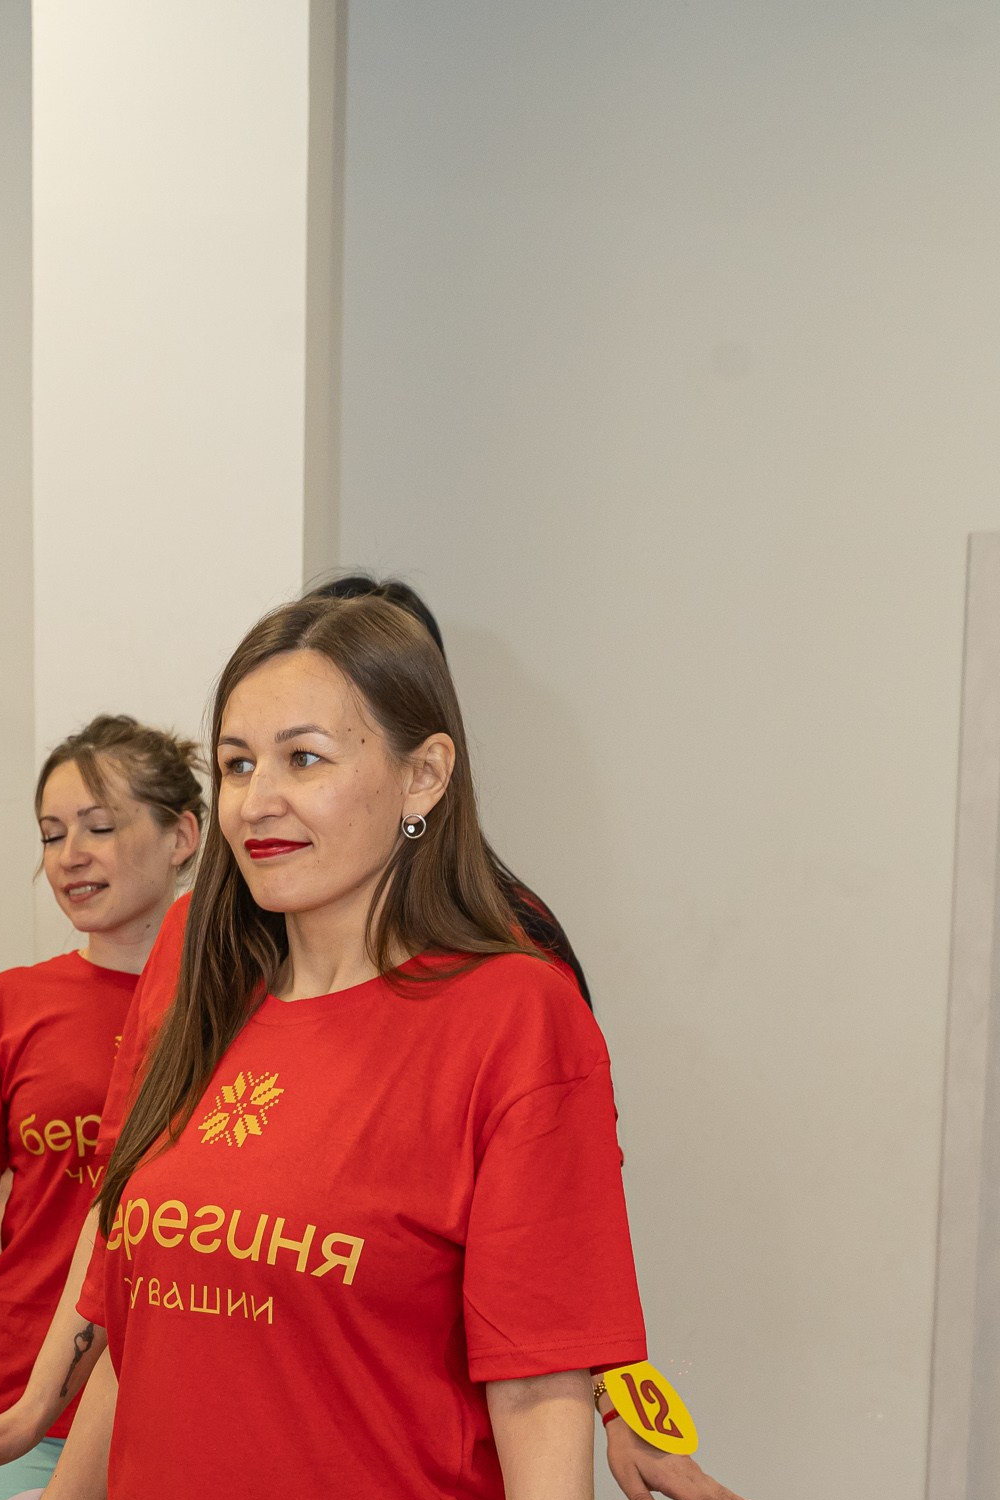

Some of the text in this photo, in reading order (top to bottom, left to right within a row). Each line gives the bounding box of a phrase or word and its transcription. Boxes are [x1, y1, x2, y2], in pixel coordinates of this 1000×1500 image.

[106, 1197, 366, 1287] ерегиня
[123, 1275, 274, 1325] увашии
[620, 1372, 684, 1439] 12
